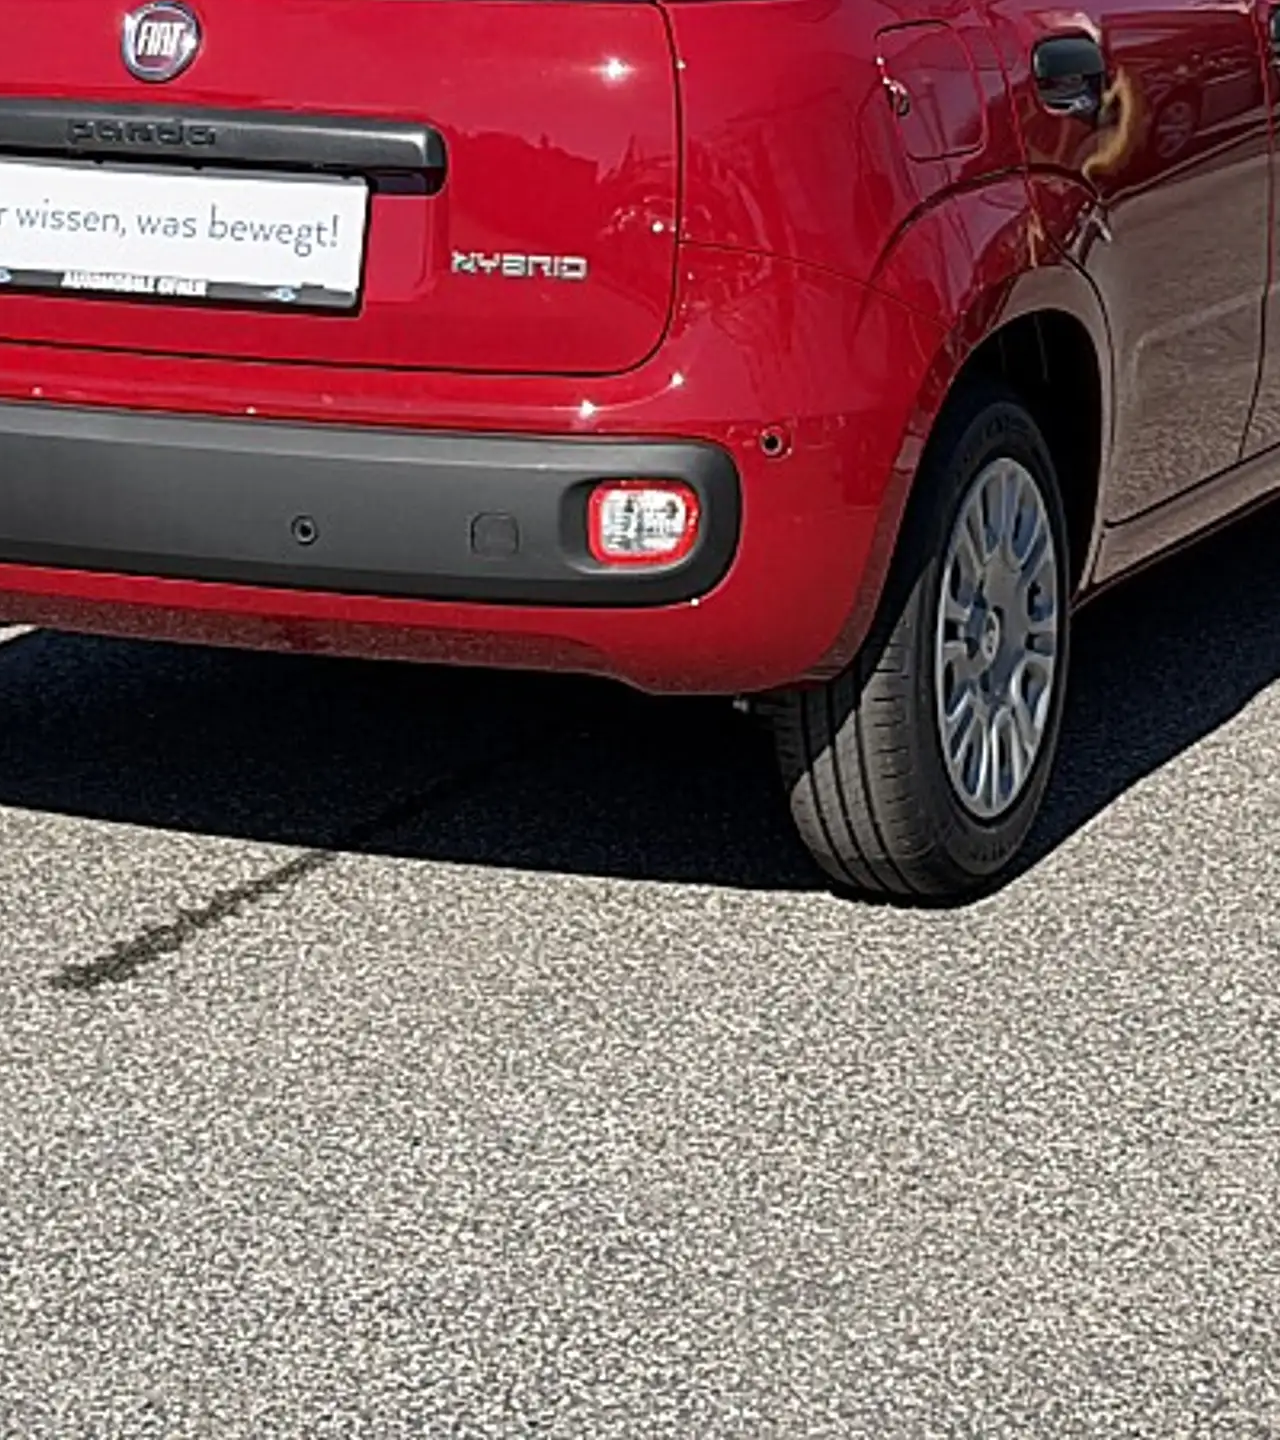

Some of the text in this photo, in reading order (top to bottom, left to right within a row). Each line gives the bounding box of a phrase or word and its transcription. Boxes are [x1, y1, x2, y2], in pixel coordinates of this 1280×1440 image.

[137, 21, 186, 56] FIAT
[16, 198, 127, 238] wissen,
[137, 212, 197, 238] was
[208, 204, 340, 258] bewegt!
[451, 250, 588, 280] HYBRID
